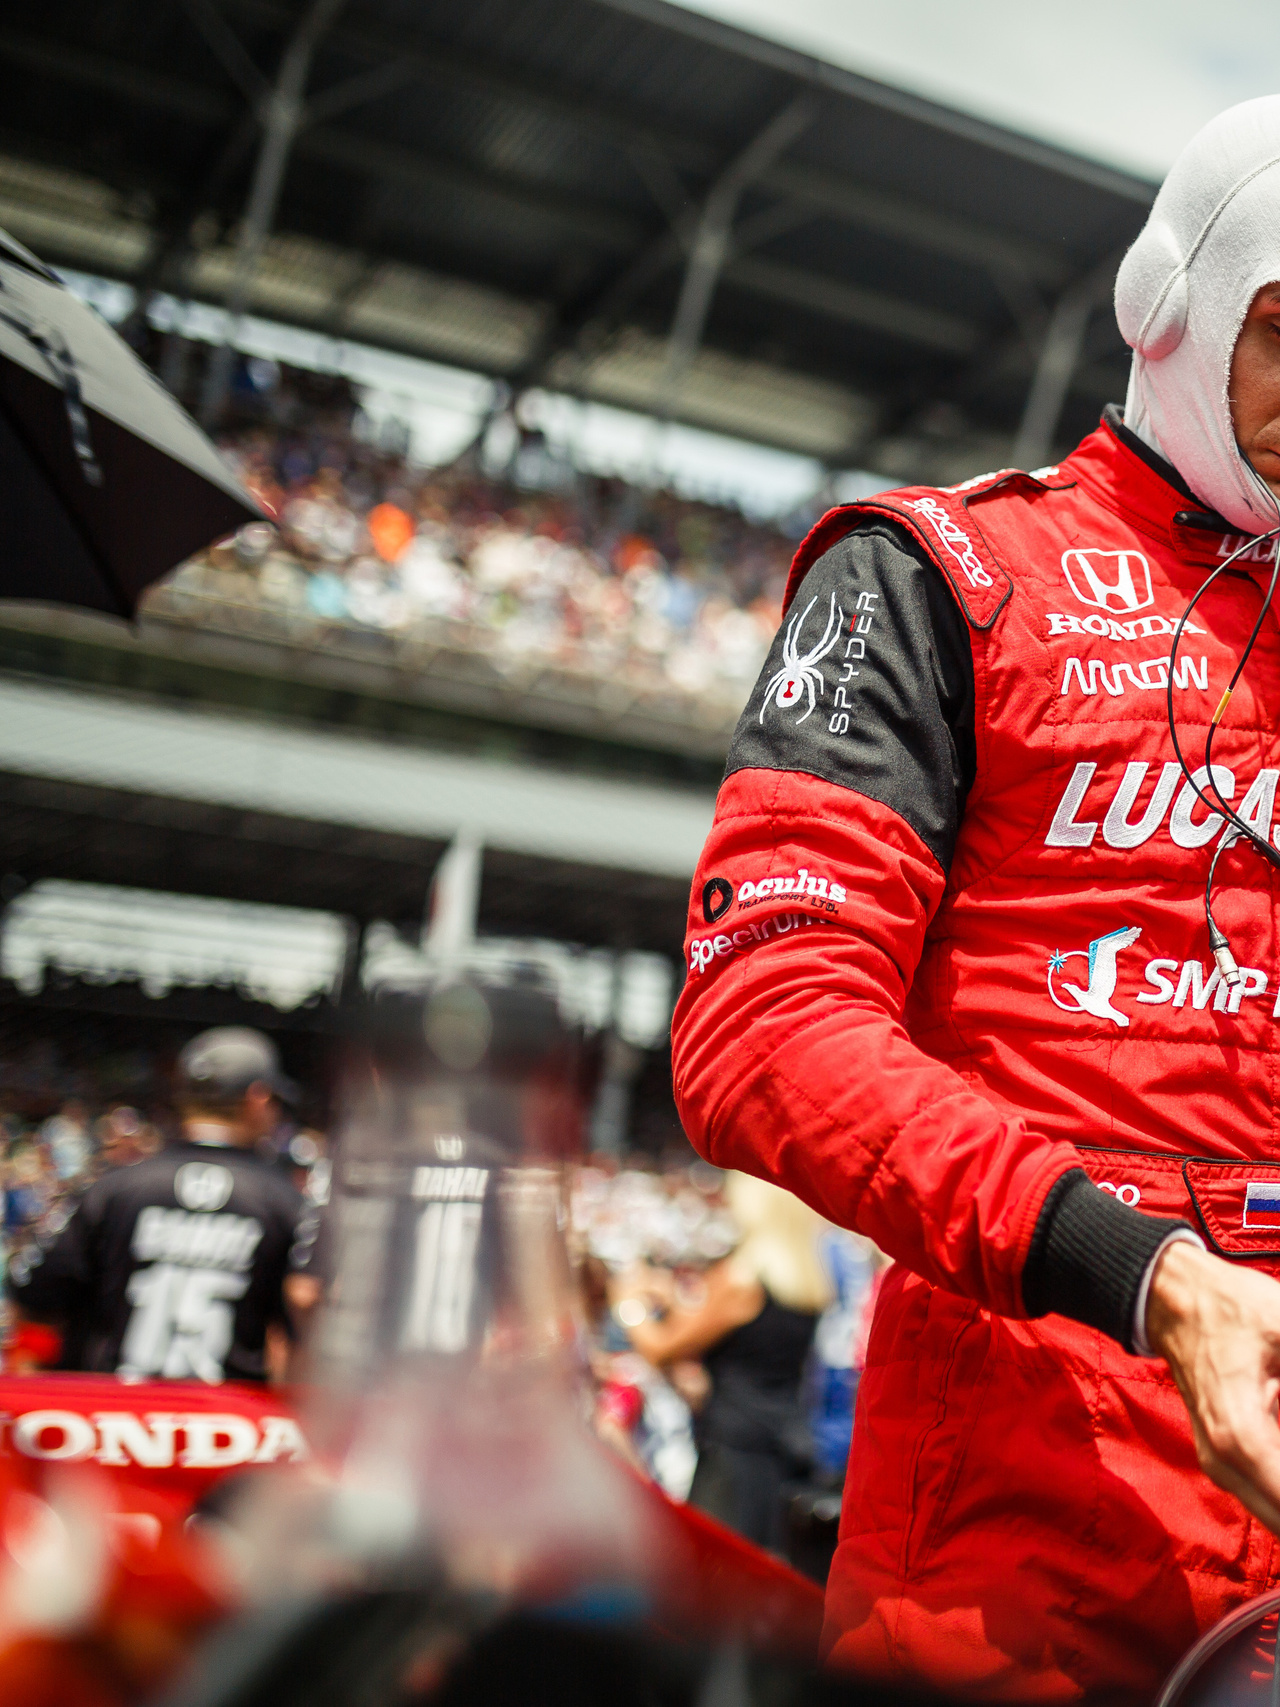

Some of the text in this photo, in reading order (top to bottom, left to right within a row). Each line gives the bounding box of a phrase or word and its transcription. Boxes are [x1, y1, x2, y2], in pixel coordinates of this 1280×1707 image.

[902, 497, 993, 588] sparco
[1046, 613, 1207, 641] HONDA
[829, 591, 879, 735] SPYDER
[738, 868, 846, 903] oculus
[1136, 958, 1269, 1014] SMP
[0, 1409, 309, 1468] ONDA
